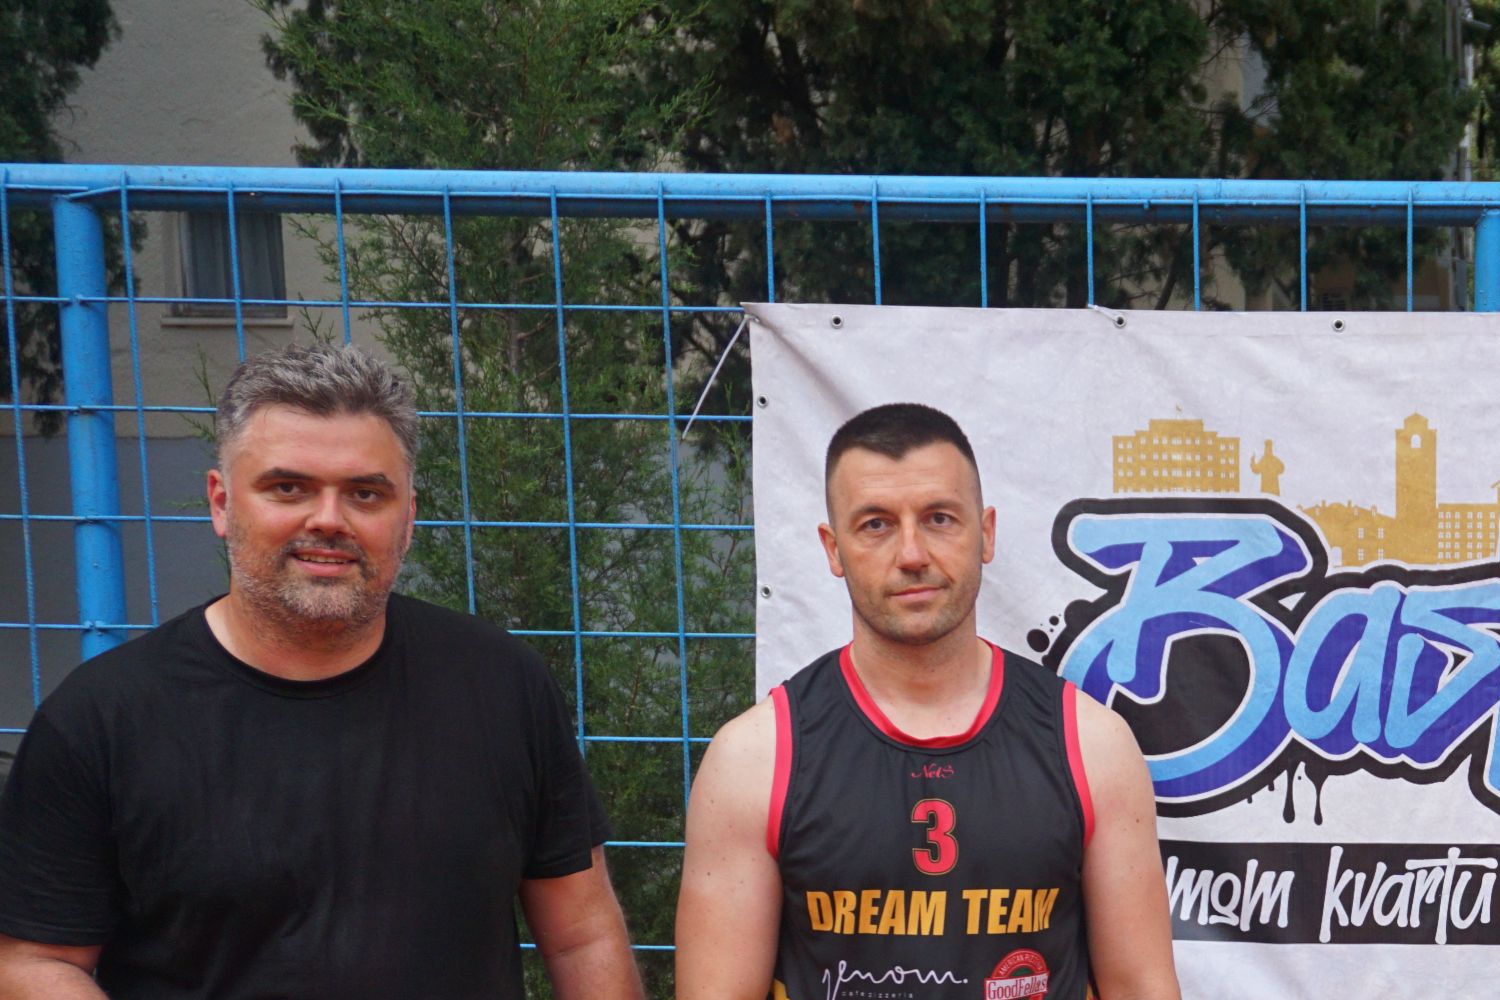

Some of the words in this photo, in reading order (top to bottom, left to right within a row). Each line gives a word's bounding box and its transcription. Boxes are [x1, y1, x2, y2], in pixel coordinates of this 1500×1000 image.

[911, 798, 960, 876] 3
[806, 889, 948, 936] DREAM
[962, 887, 1060, 935] TEAM
[1319, 845, 1499, 945] kvartu
